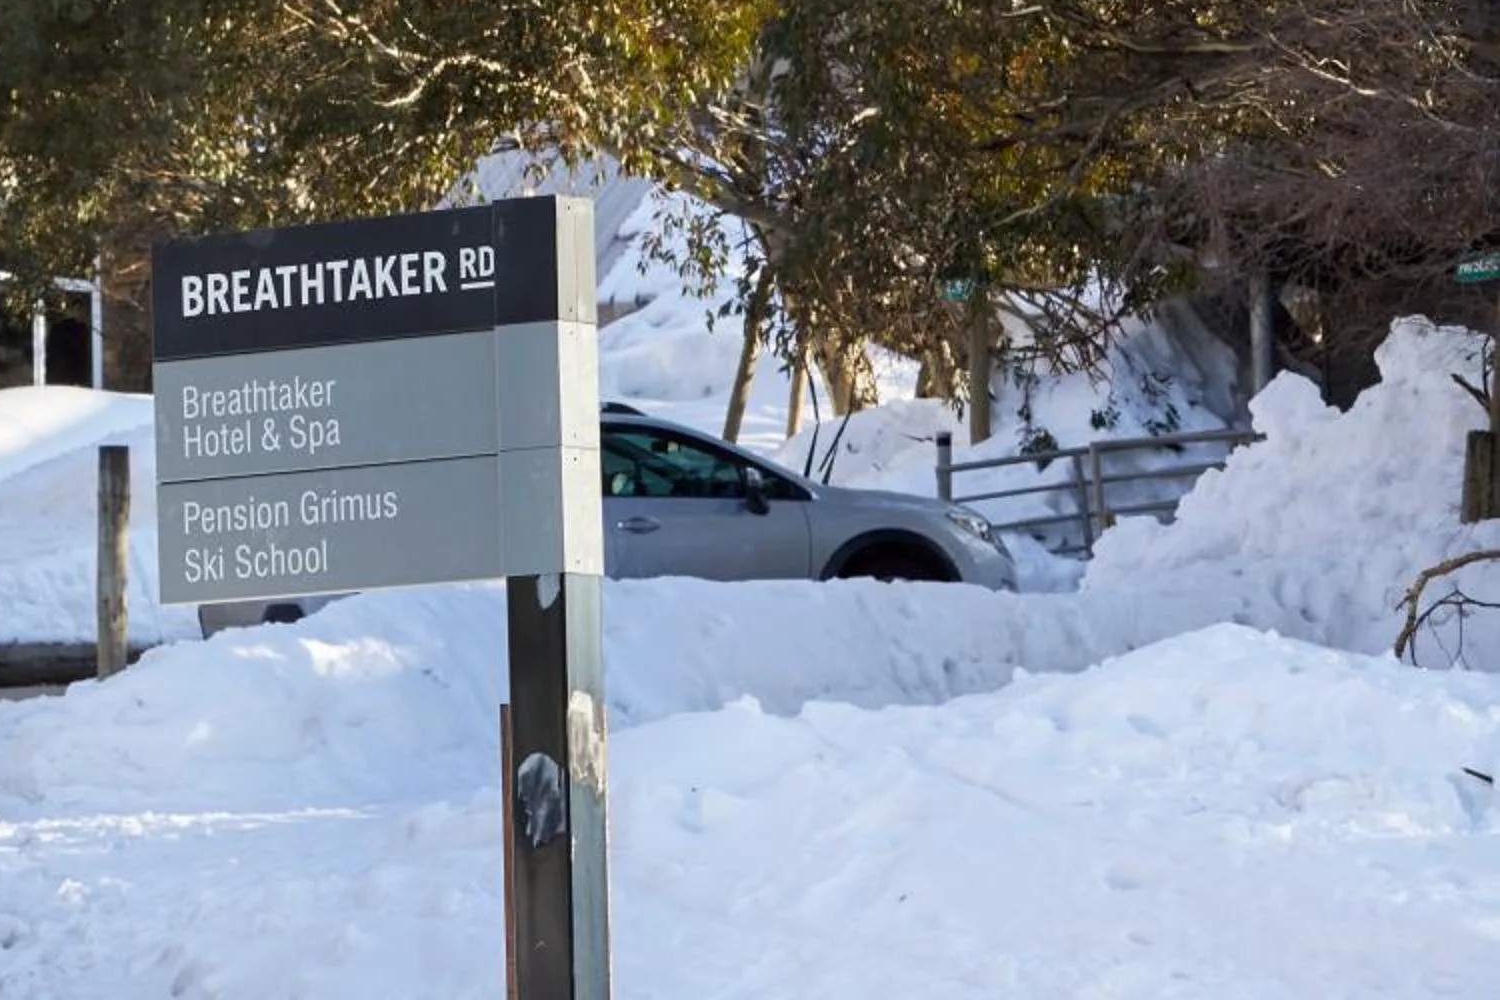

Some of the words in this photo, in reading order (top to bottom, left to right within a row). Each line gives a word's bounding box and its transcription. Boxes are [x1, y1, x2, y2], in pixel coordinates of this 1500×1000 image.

[181, 251, 447, 318] BREATHTAKER
[459, 246, 495, 279] RD
[182, 376, 336, 419] Breathtaker
[184, 420, 251, 458] Hotel
[261, 419, 281, 451] &
[289, 415, 340, 454] Spa
[184, 497, 289, 535] Pension
[301, 490, 398, 524] Grimus
[184, 547, 224, 584] Ski
[235, 541, 328, 579] School
